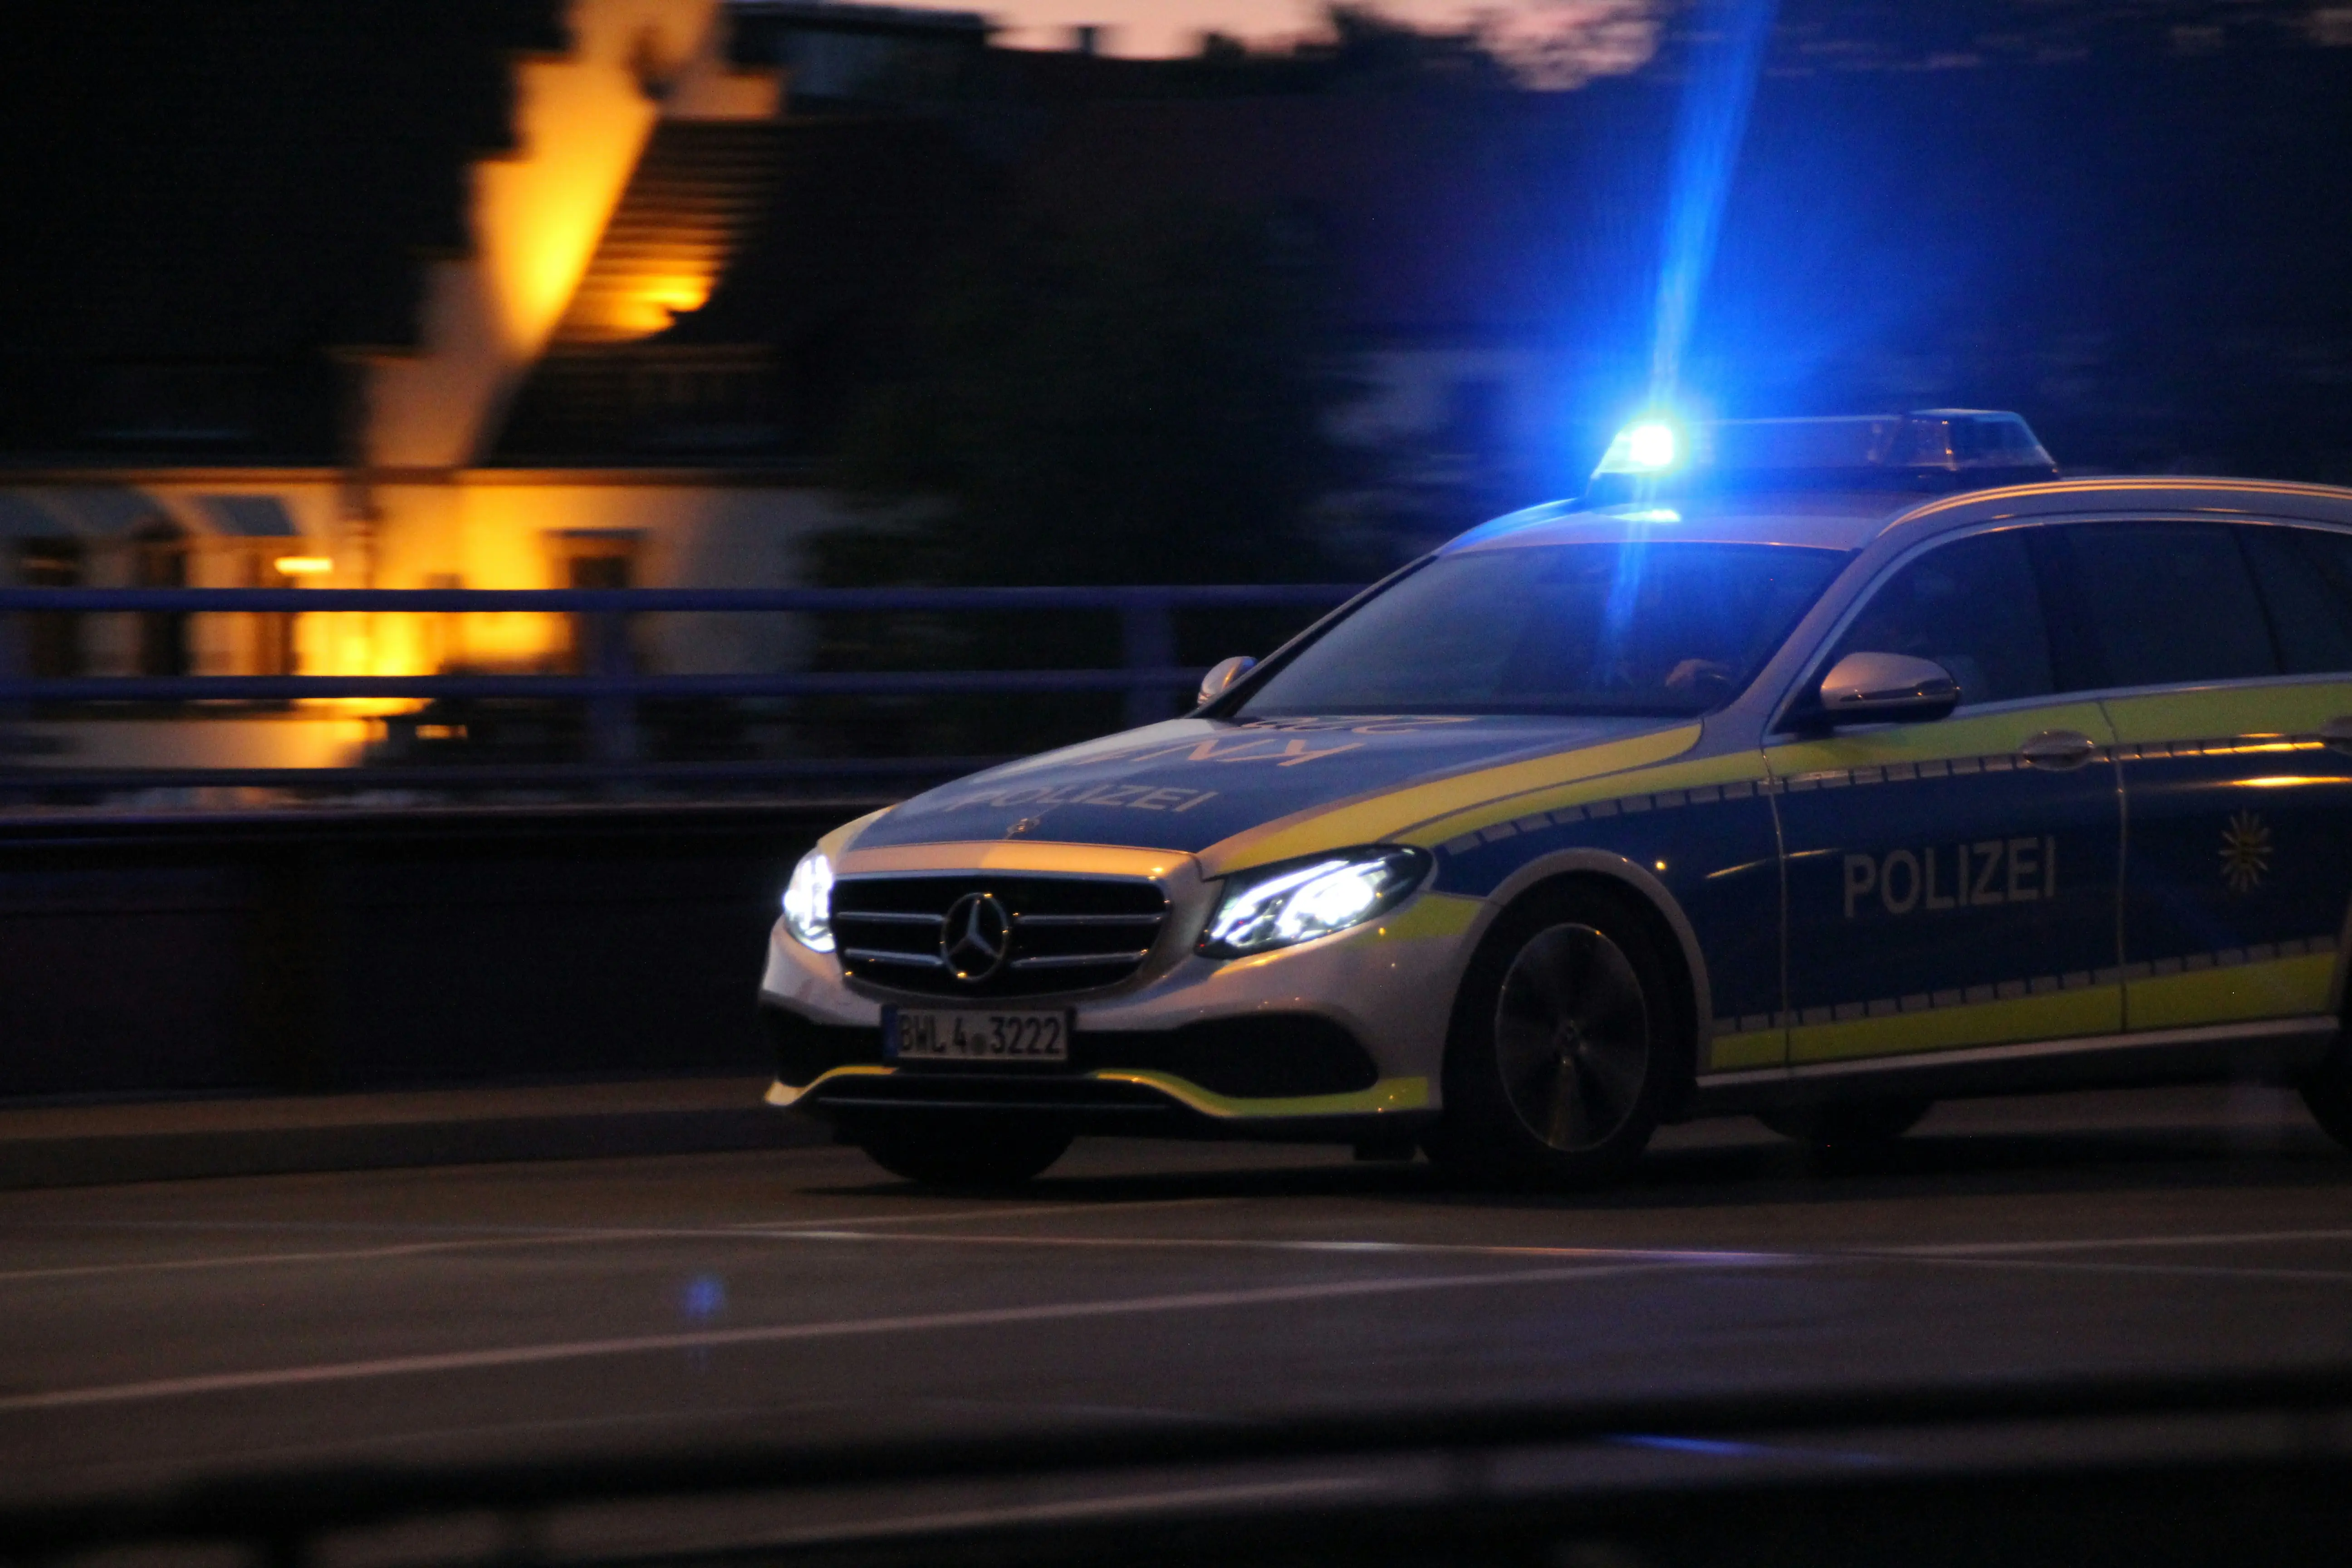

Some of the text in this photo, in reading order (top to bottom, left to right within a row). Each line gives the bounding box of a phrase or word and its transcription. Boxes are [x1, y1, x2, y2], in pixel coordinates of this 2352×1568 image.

[943, 784, 1219, 812] POLIZEI
[1843, 835, 2055, 918] POLIZEI
[953, 1016, 967, 1054] 4
[989, 1015, 1061, 1054] 3222
